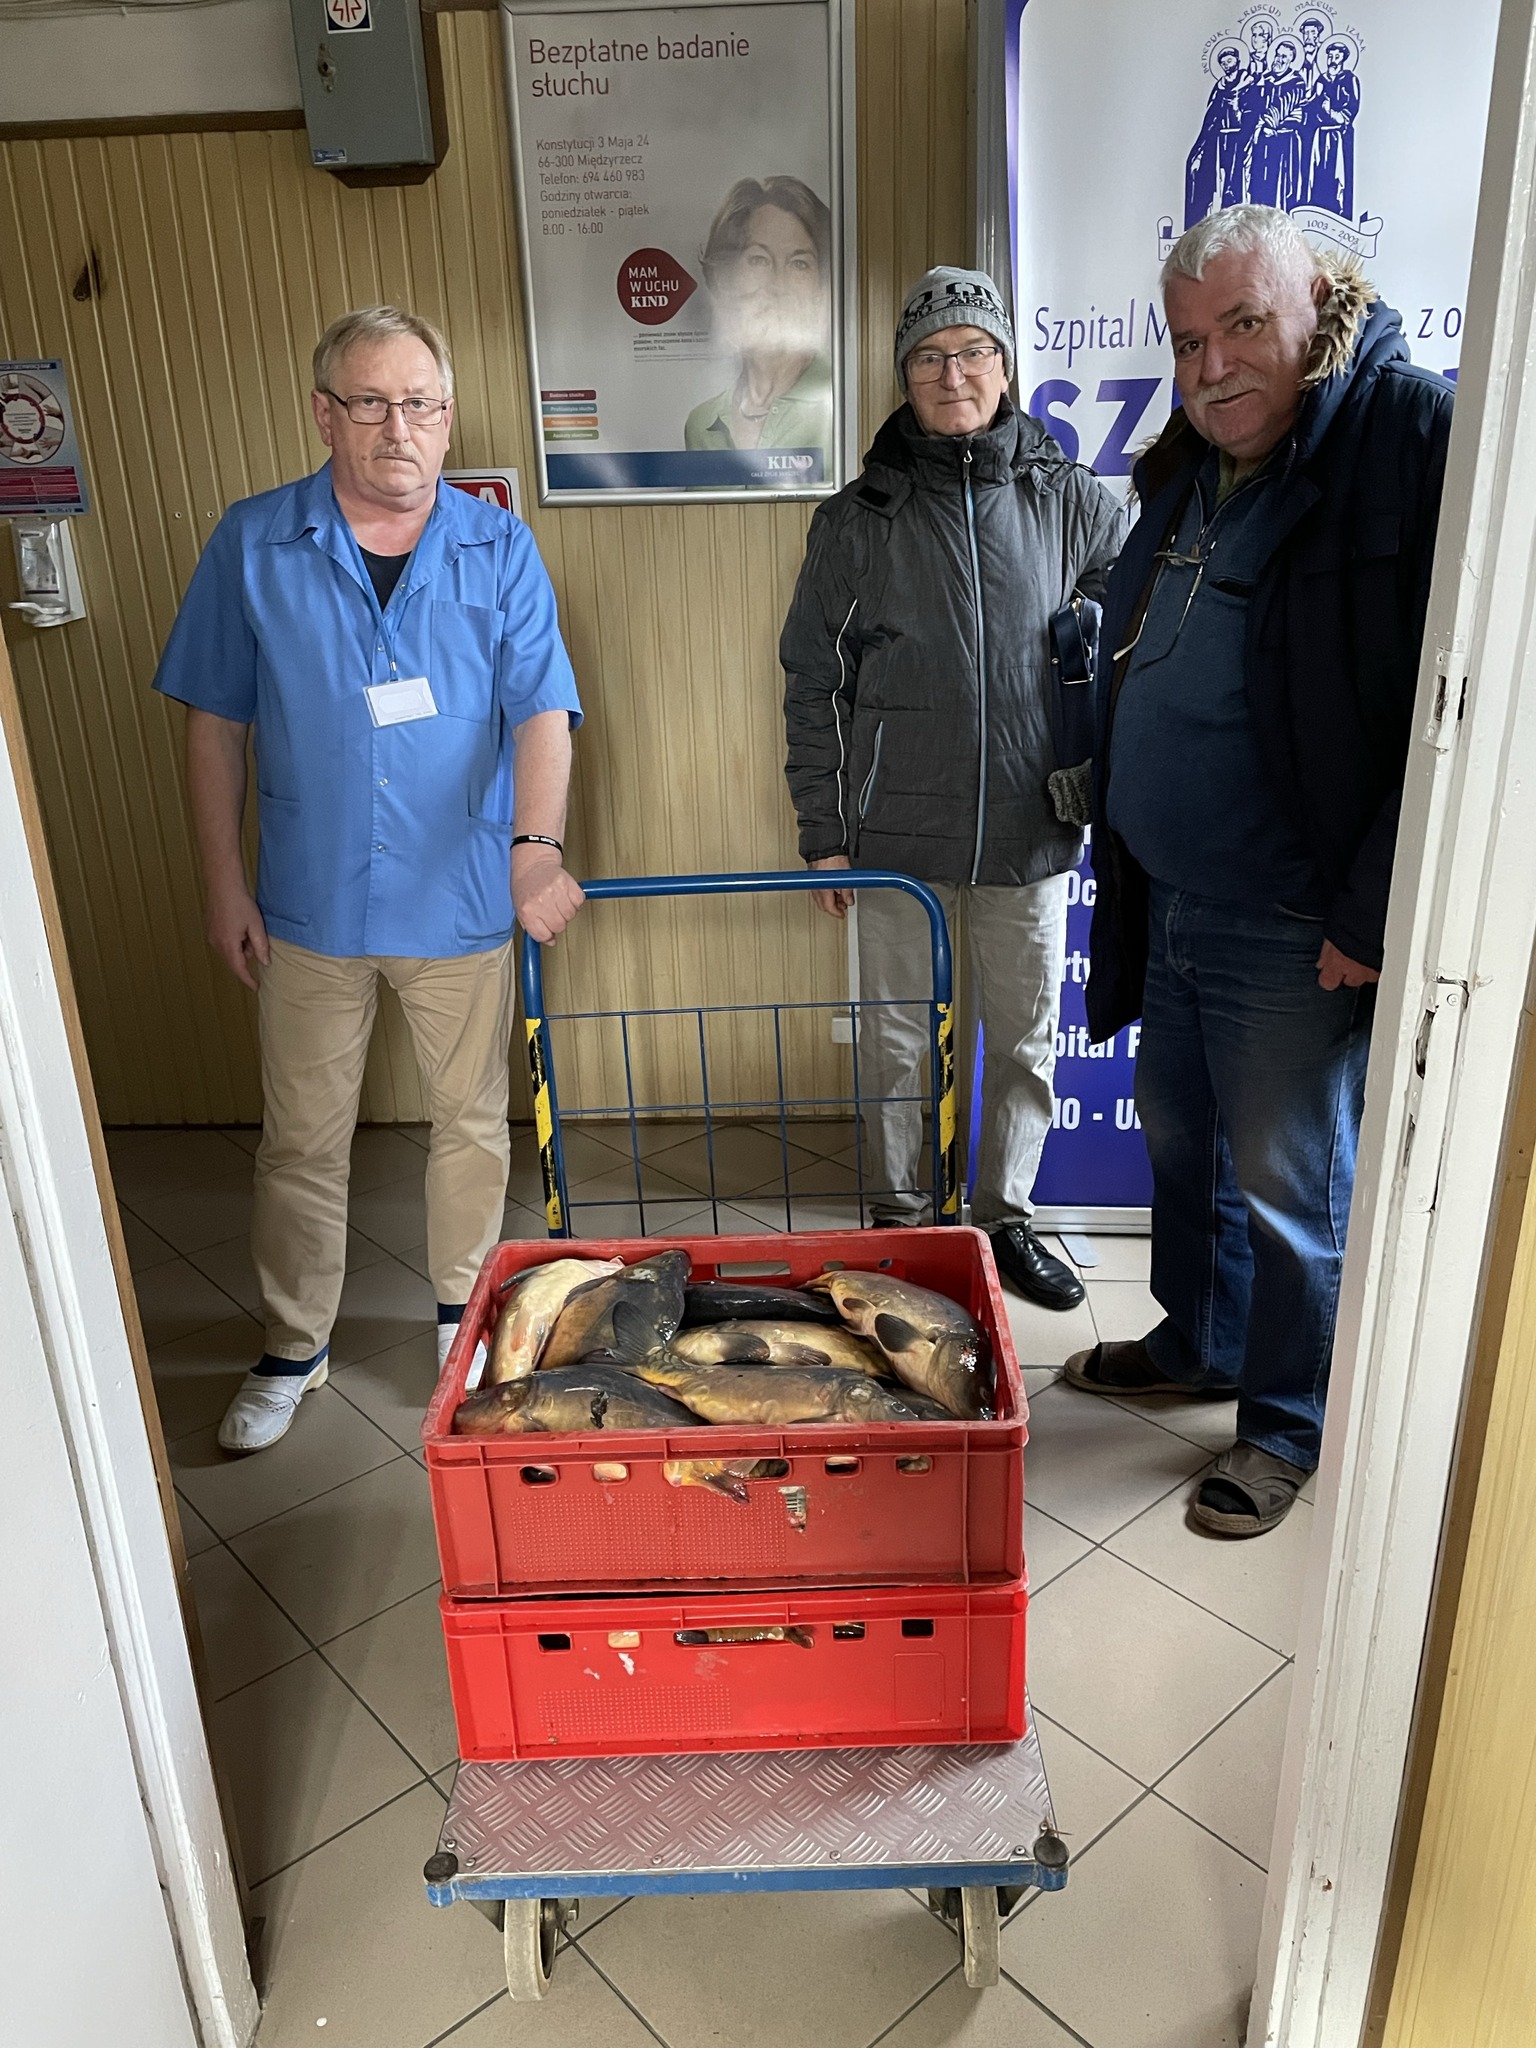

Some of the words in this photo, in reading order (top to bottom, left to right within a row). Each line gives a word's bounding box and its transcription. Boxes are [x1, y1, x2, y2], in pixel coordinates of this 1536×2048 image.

[529, 38, 649, 69] Bezpłatne
[657, 31, 750, 60] badanie
[532, 70, 609, 97] słuchu
[536, 137, 595, 152] Konstytucji
[597, 136, 605, 148] 3
[607, 136, 634, 150] Maja
[636, 134, 650, 147] 24
[538, 155, 575, 168] 66-300
[577, 154, 643, 169] Międzyrzecz
[539, 172, 580, 185] Telefon:
[582, 171, 600, 184] 694
[603, 170, 623, 183] 460
[625, 169, 646, 181] 983
[540, 190, 581, 204] Godziny
[583, 190, 632, 201] otwarcia:
[541, 205, 607, 221] poniedziałek
[618, 204, 650, 219] piątek
[542, 223, 565, 236] 8:00
[577, 222, 604, 235] 16:00
[1307, 219, 1329, 231] 1003
[1338, 230, 1360, 245] 2003
[629, 266, 658, 279] MAM
[630, 281, 642, 293] W
[645, 279, 679, 292] UCHU
[631, 295, 669, 308] KIND
[1033, 298, 1135, 369] Szpital
[767, 455, 814, 469] KIND
